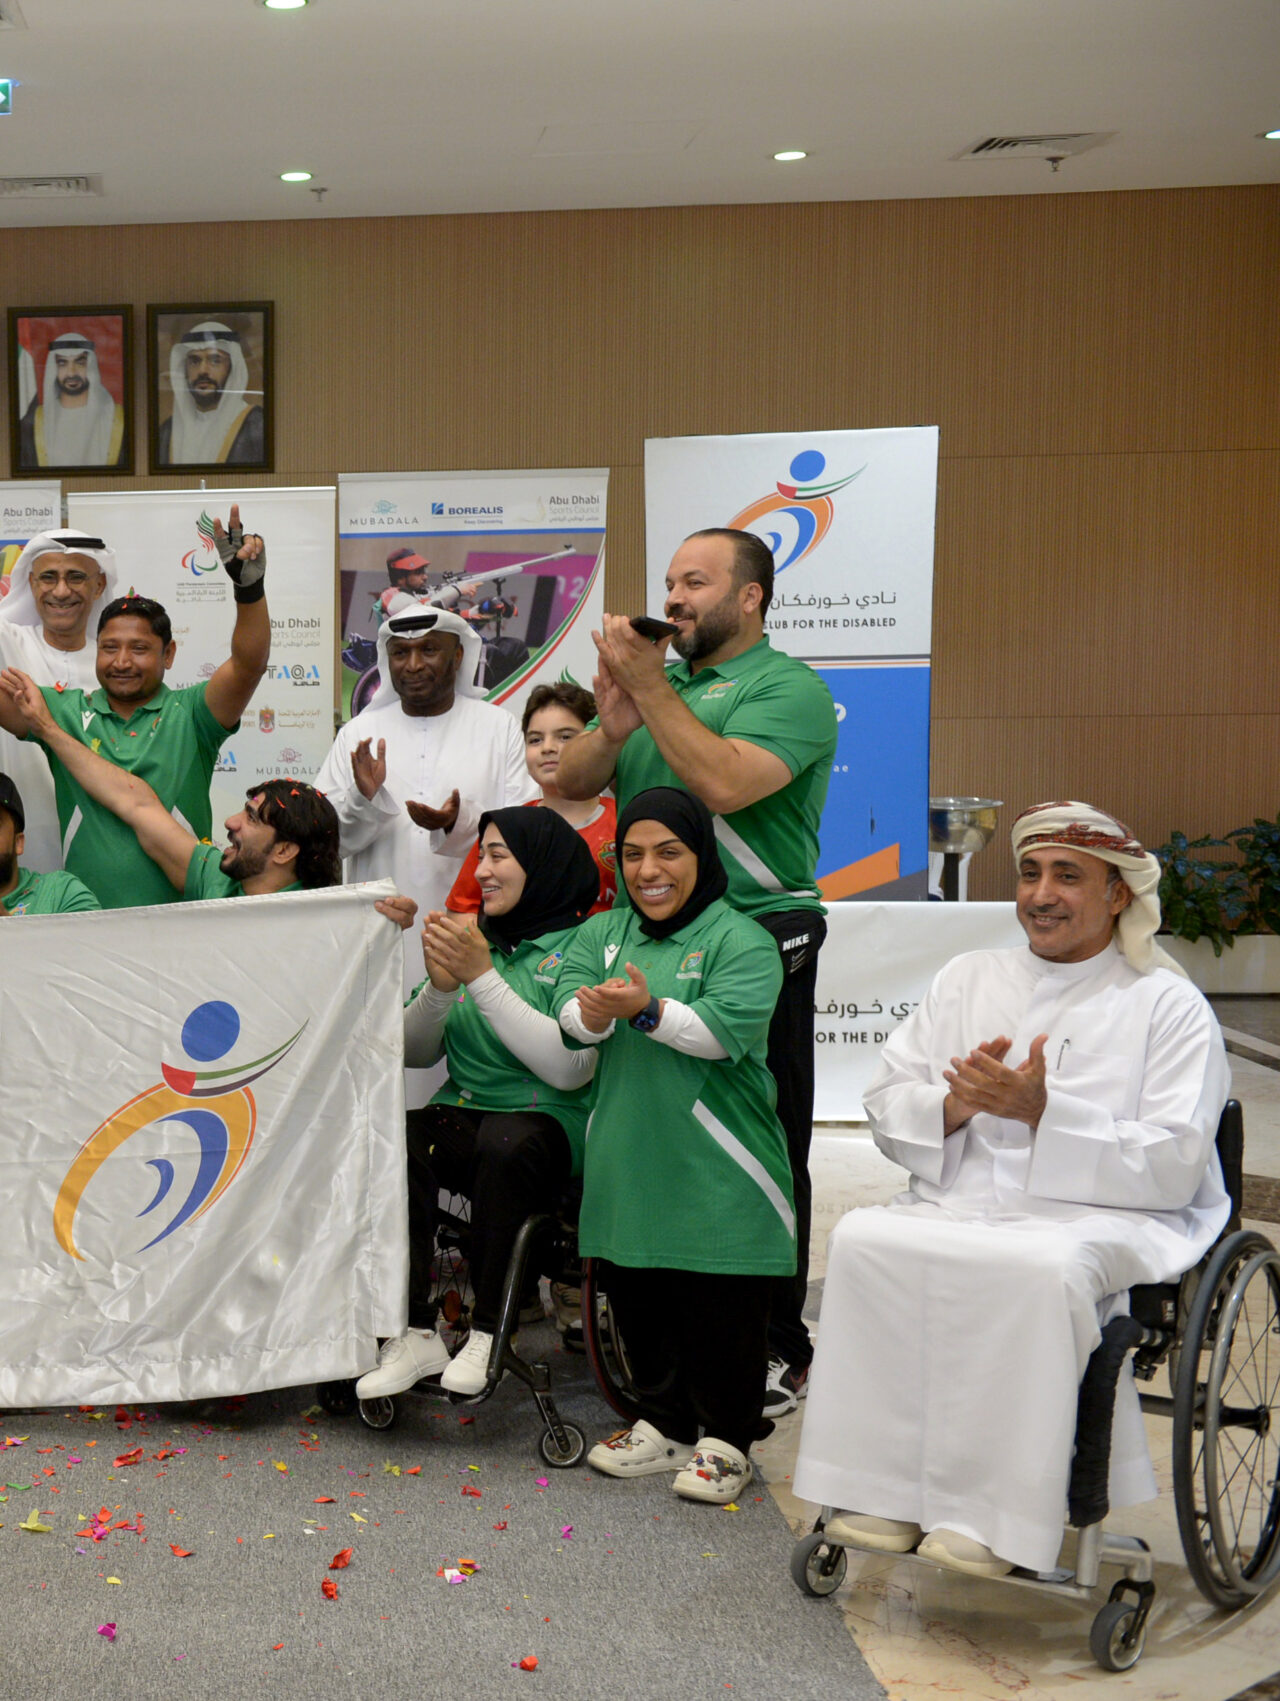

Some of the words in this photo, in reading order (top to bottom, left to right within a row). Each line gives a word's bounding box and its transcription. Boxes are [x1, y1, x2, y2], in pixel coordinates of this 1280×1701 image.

[549, 495, 569, 505] Abu
[571, 495, 600, 505] Dhabi
[3, 507, 23, 517] Abu
[25, 506, 54, 517] Dhabi
[448, 506, 504, 515] BOREALIS
[349, 517, 419, 526] MUBADALA
[770, 593, 850, 610] خورفكان
[856, 591, 897, 610] نادي
[270, 618, 285, 629] bu
[288, 617, 321, 629] Dhabi
[793, 619, 815, 629] FOR
[819, 618, 839, 628] THE
[842, 617, 897, 628] DISABLED
[267, 664, 320, 680] TAQA
[783, 933, 810, 951] NIKE
[815, 1032, 836, 1043] OR
[842, 1031, 868, 1043] THE
